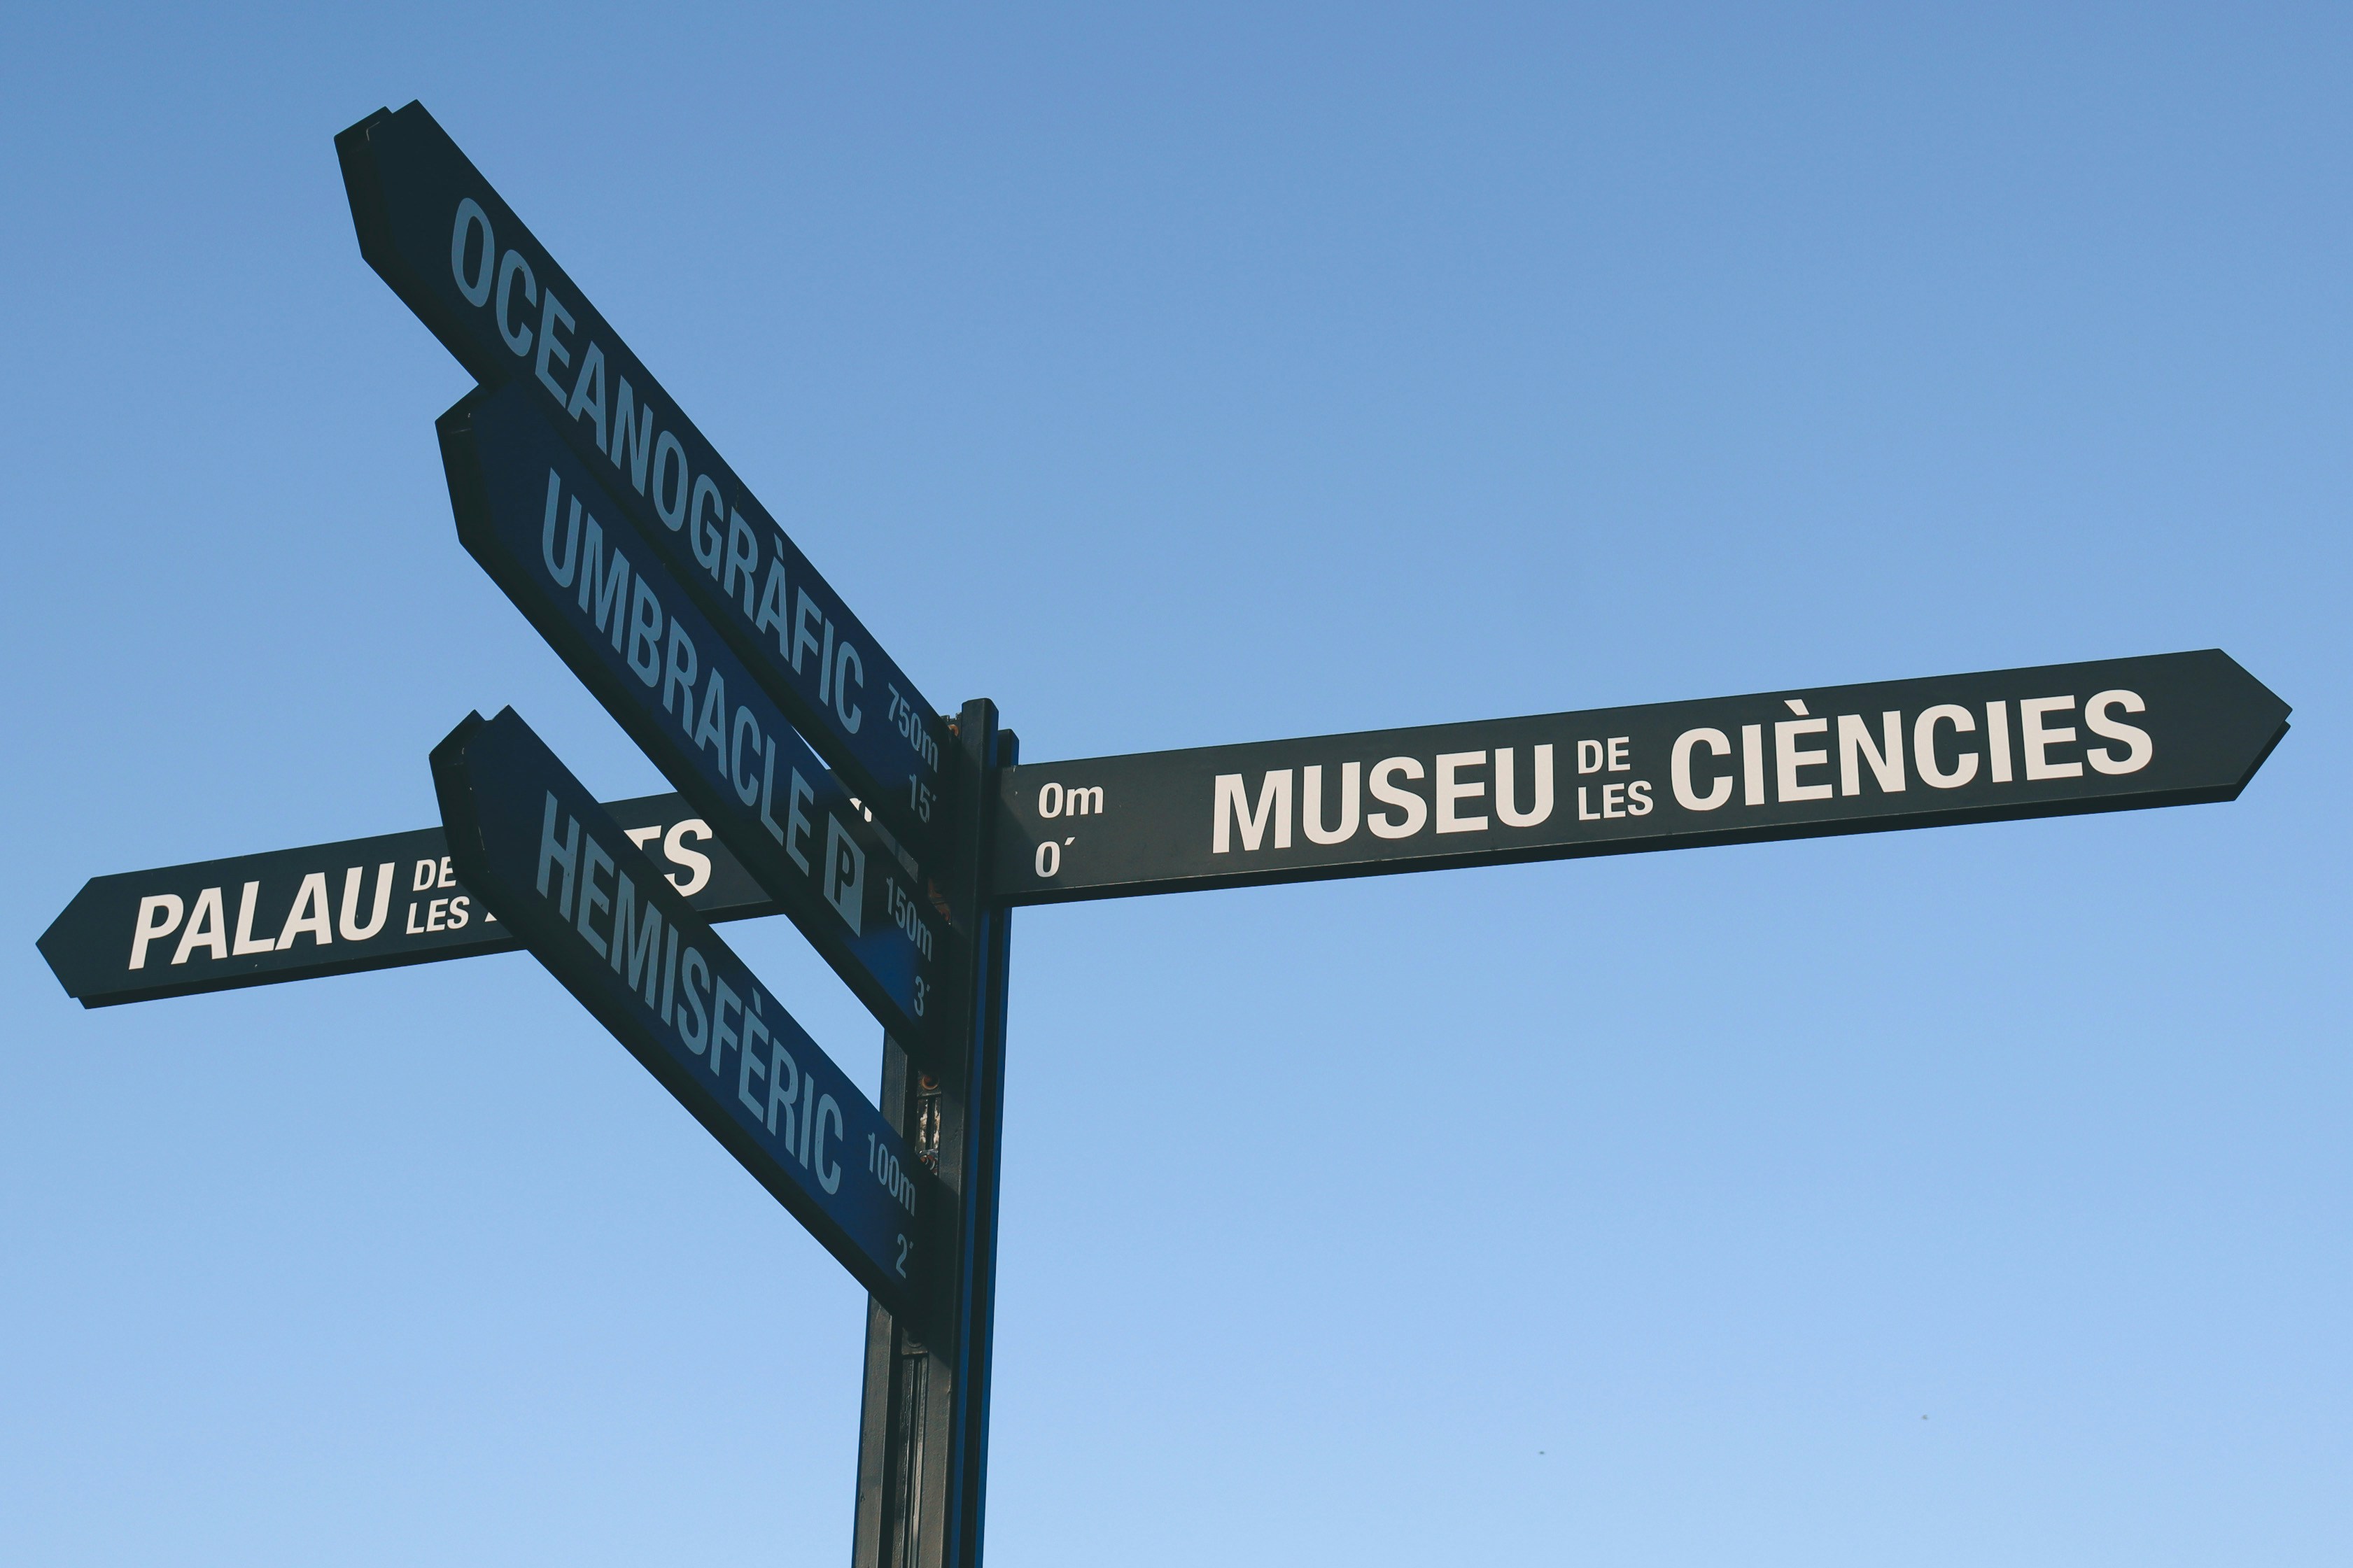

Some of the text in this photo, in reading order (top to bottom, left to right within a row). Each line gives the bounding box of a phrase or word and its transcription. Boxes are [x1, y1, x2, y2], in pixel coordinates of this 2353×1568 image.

[451, 198, 863, 734] OCEANOGRÀFIC
[542, 467, 813, 877] UMBRACLE
[888, 682, 939, 773] 750m
[1038, 782, 1104, 819] 0m
[1212, 689, 2153, 854] MUSEU DE LES CIÈNCIES
[128, 856, 470, 970] PALAU DE LES
[886, 877, 932, 962] 150m
[536, 790, 843, 1194] HEMISFÈRIC
[867, 1131, 916, 1217] 100m
